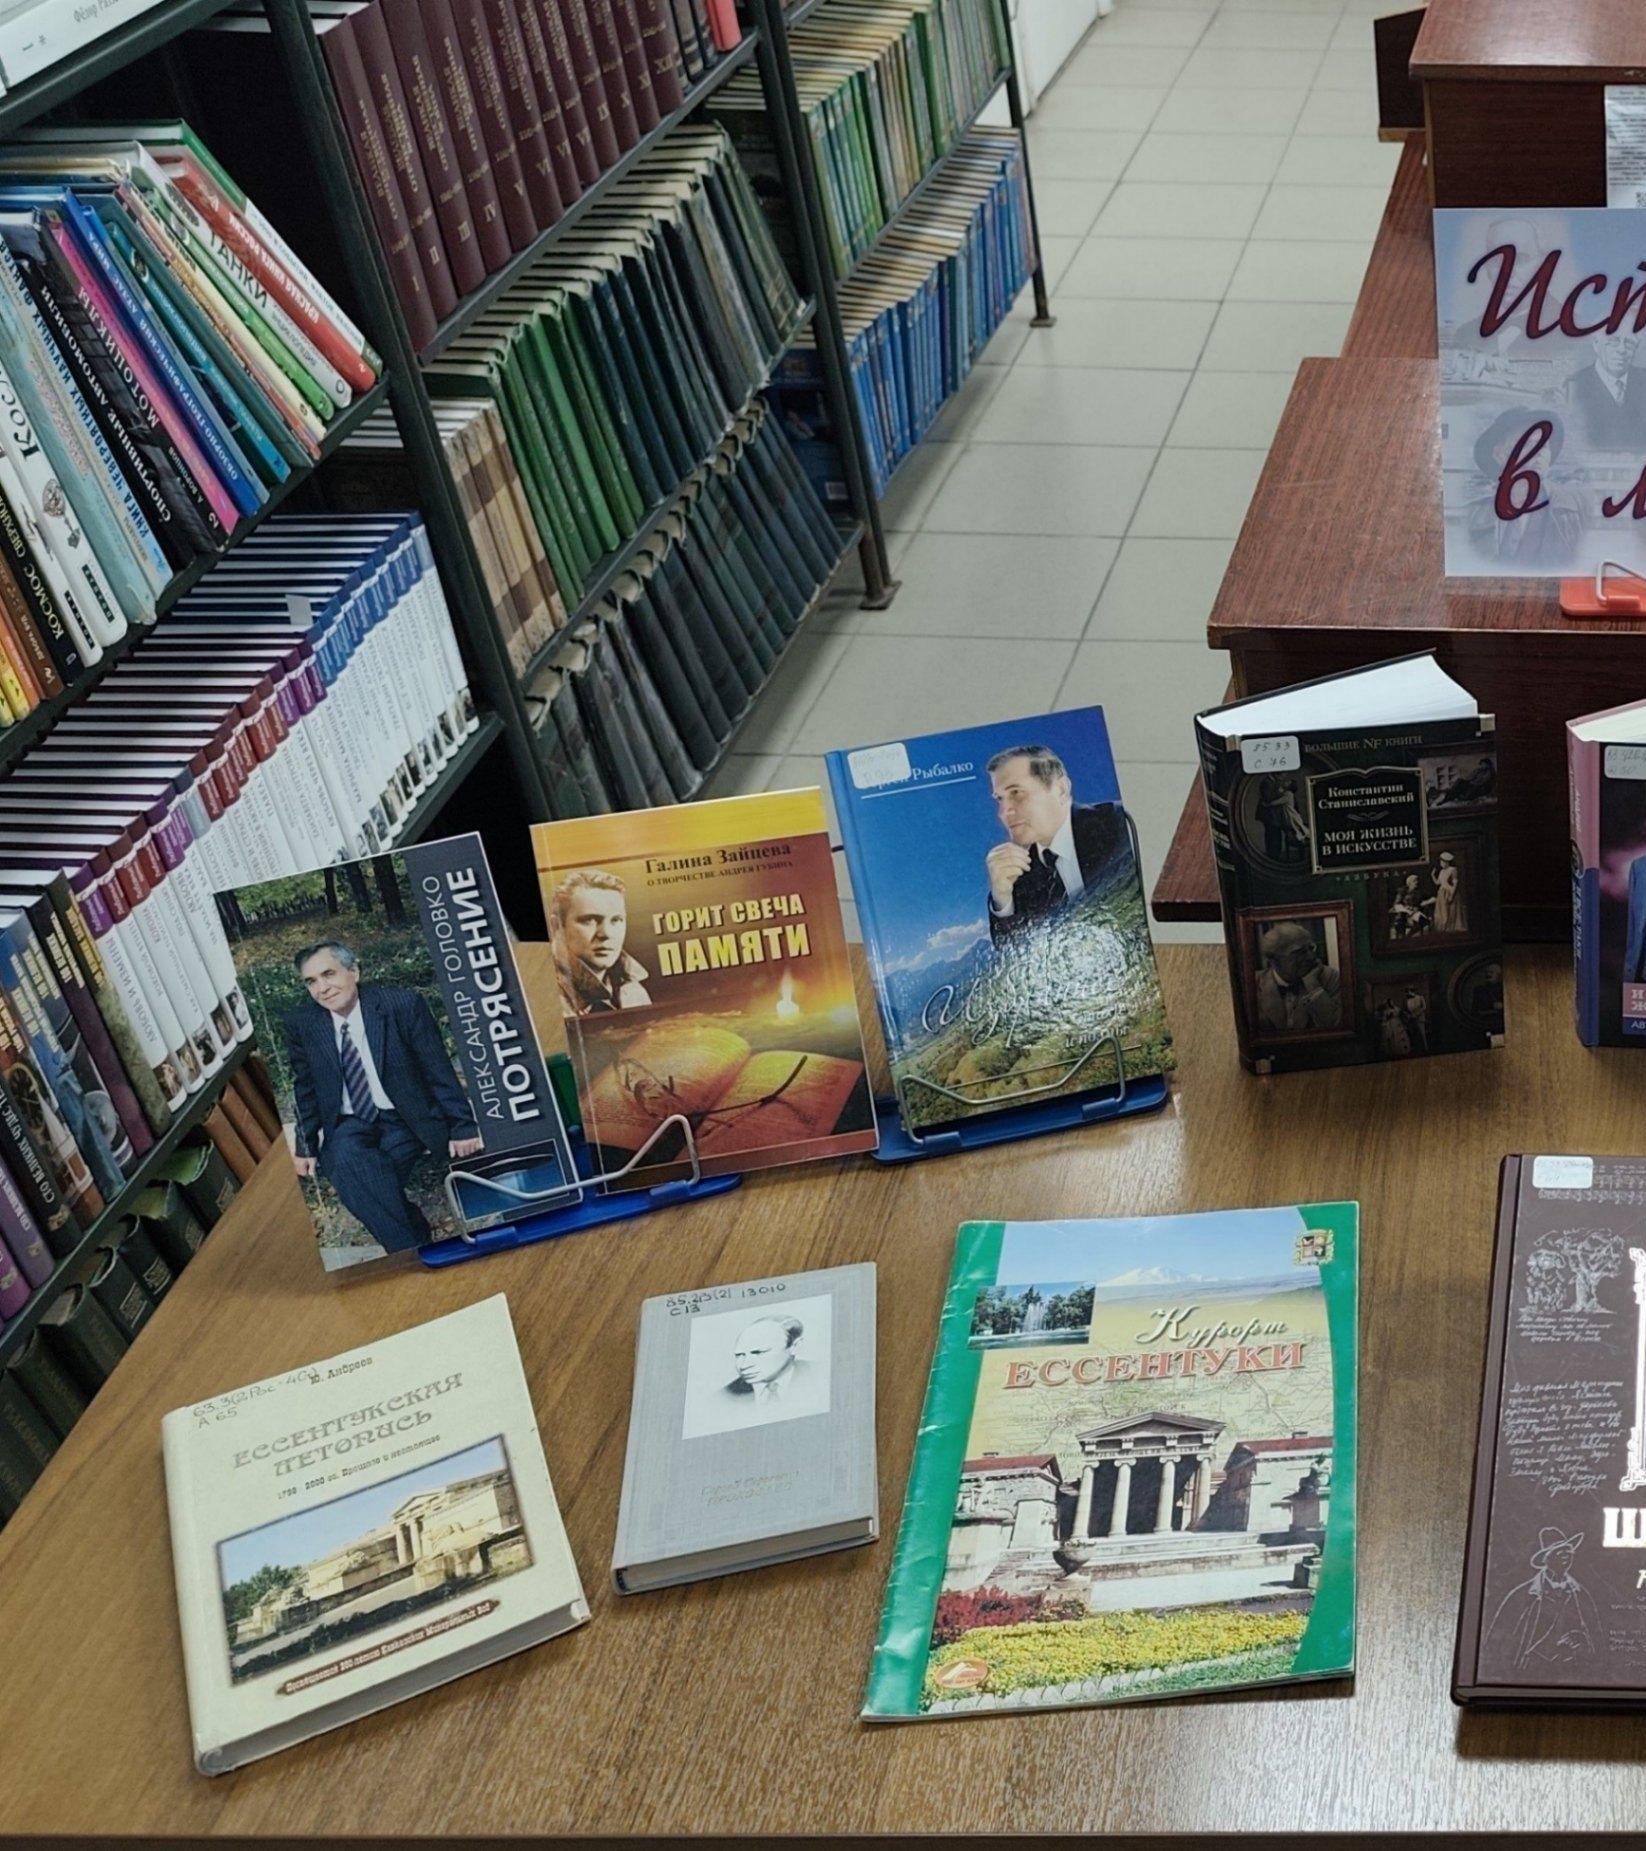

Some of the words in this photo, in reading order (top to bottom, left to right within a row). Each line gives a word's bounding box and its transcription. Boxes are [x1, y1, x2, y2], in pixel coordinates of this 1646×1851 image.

[38, 282, 109, 407] АВТОМОБИЛИ
[70, 285, 164, 428] МОТОЦИКЛЫ
[137, 317, 239, 480] ОБЗОРНО-ГЕОГРАФИЧЕСКИЙ
[105, 405, 174, 524] СПОРТИВНЫЕ
[1494, 420, 1553, 521] в
[22, 560, 66, 641] КОСМОС
[912, 760, 974, 780] Рыбалко
[1328, 784, 1404, 798] Константин
[1318, 793, 1415, 810] Станиславский
[645, 855, 712, 874] Галина
[718, 843, 791, 866] Зайцева
[1322, 845, 1332, 856] В
[1336, 838, 1417, 856] ИСКУССТВЕ
[1324, 831, 1355, 843] МОЯ
[1359, 825, 1413, 841] ЖИЗНЬ
[422, 876, 463, 985] ГОЛОВКО
[653, 904, 725, 935] ГОРИТ
[730, 893, 806, 924] СВЕЧА
[657, 923, 812, 978] ПАМЯТИ
[447, 867, 540, 1123] ПОТРЯСЕНИЕ
[1631, 989, 1644, 1000] И
[448, 986, 505, 1119] АЛЕКСАНДР
[1136, 1306, 1288, 1348] Курорт
[1003, 1341, 1306, 1390] ЕССЕНТУКИ
[234, 1372, 464, 1470] ЕССЕНТУКСКАЯ
[274, 1408, 433, 1477] ЛЕТОПИСЬ
